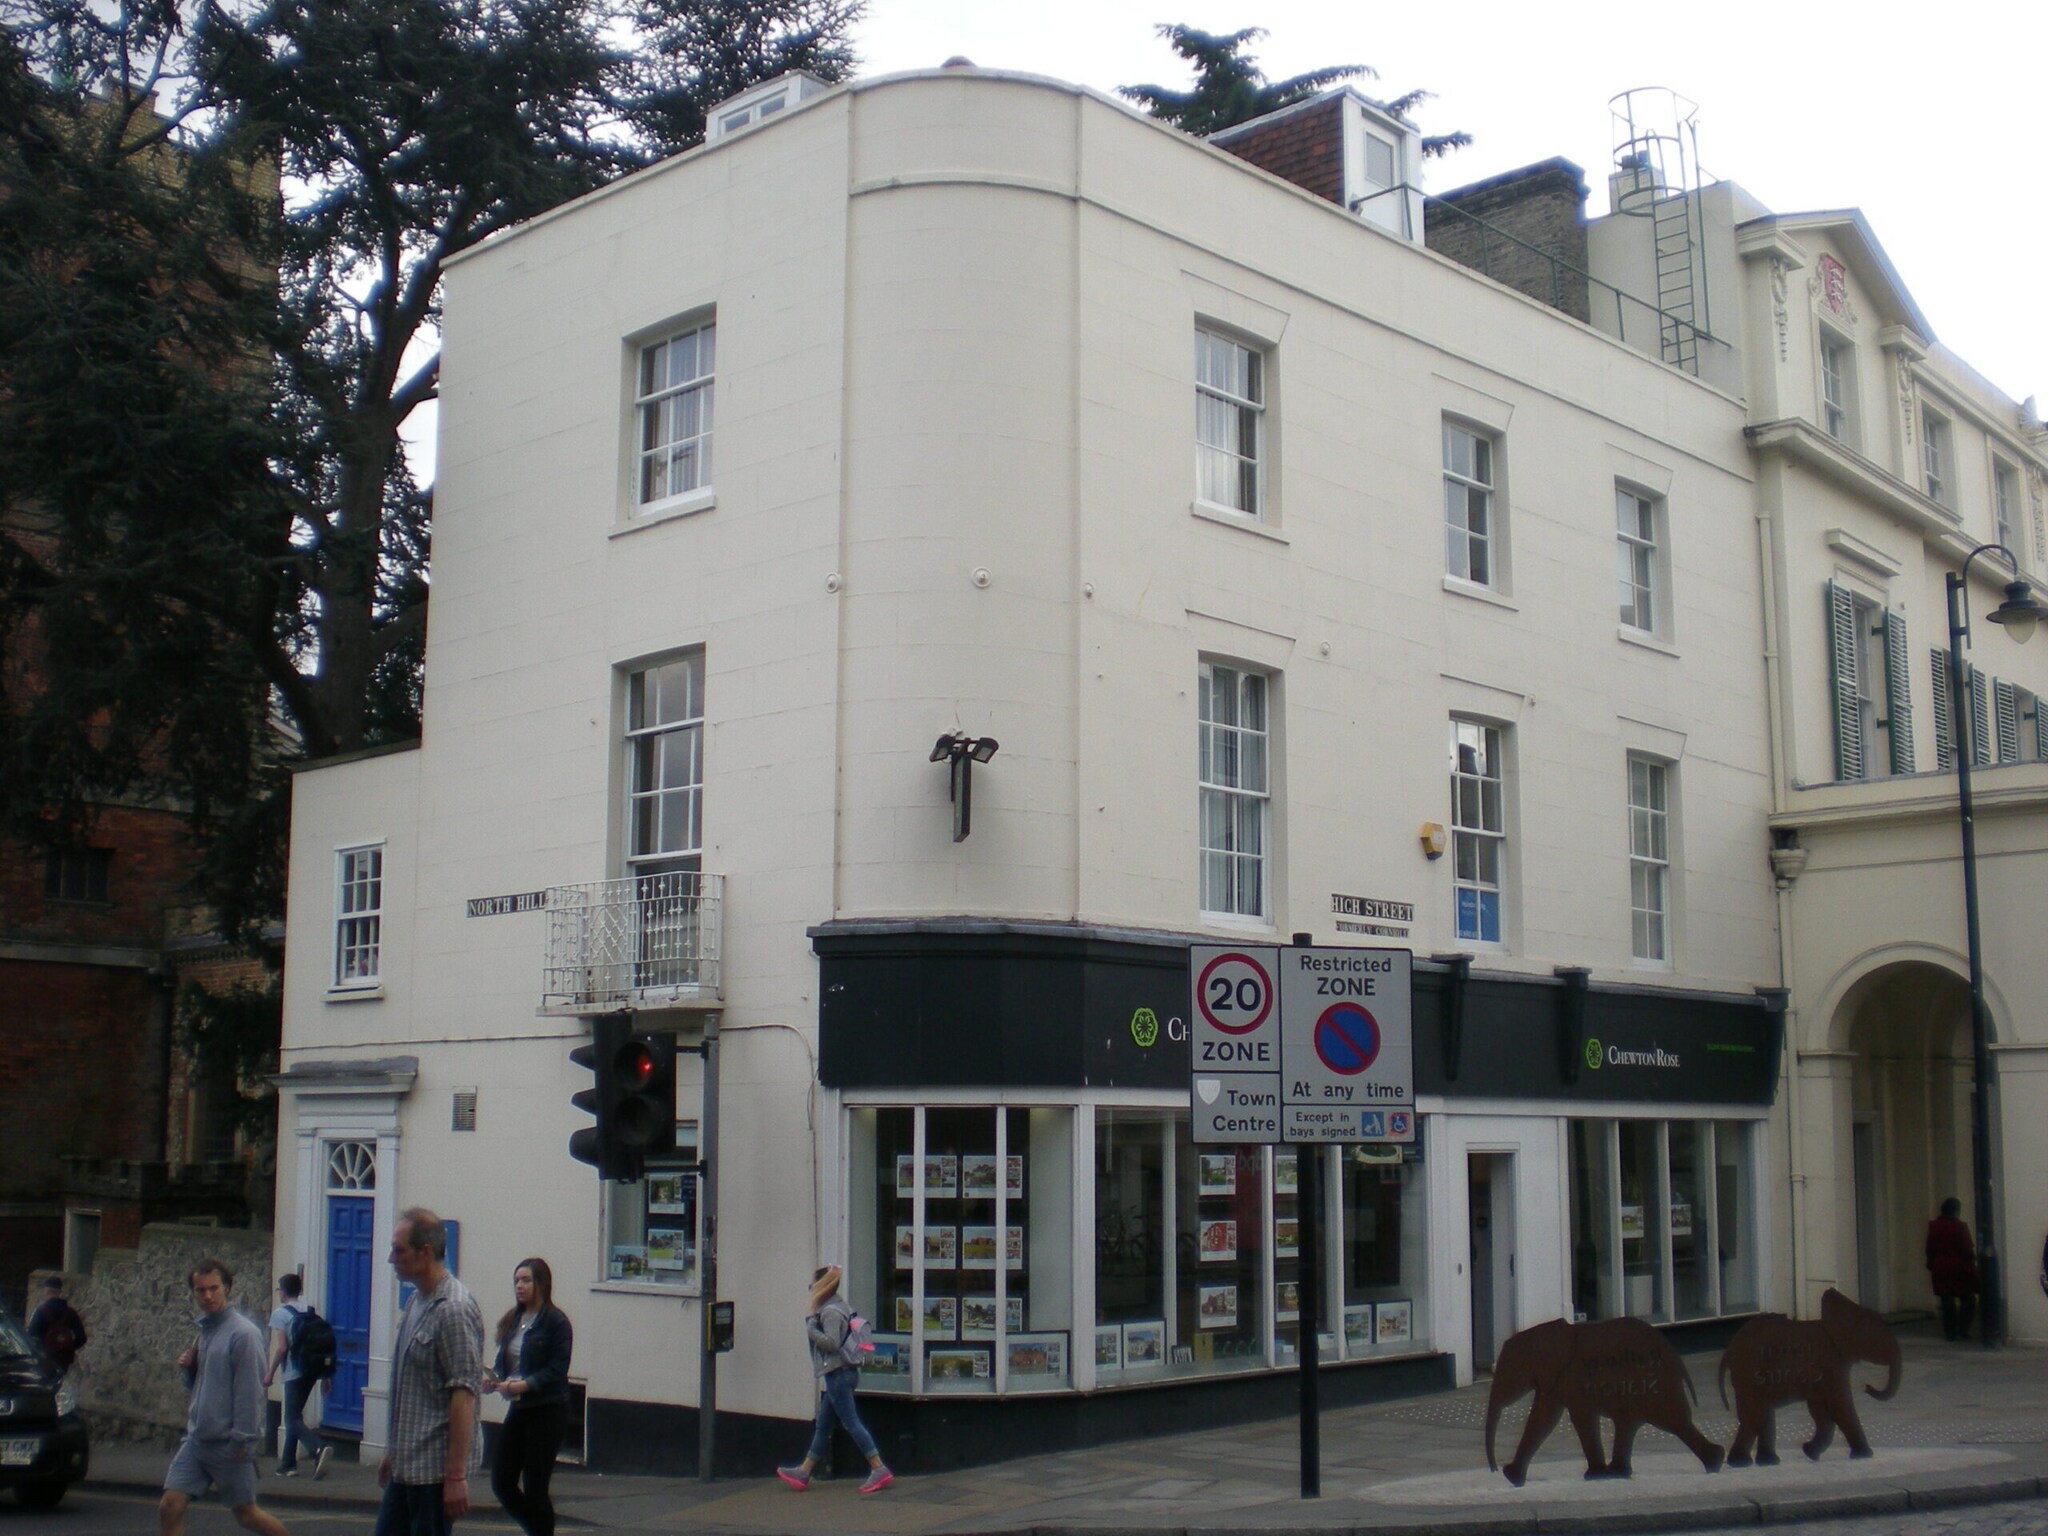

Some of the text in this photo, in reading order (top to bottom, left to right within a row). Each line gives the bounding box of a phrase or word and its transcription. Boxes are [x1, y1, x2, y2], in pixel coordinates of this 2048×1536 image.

[468, 892, 545, 917] NORTH HILL
[1331, 895, 1413, 920] HIGH STREET
[1300, 955, 1392, 973] Restricted
[1210, 977, 1261, 1011] 20
[1316, 977, 1376, 996] ZONE
[1202, 1041, 1270, 1061] ZONE
[1227, 1090, 1276, 1106] Town
[1292, 1081, 1404, 1100] At any time
[1212, 1115, 1276, 1131] Centre
[1296, 1111, 1350, 1124] Except in
[1290, 1126, 1356, 1138] bays signed
